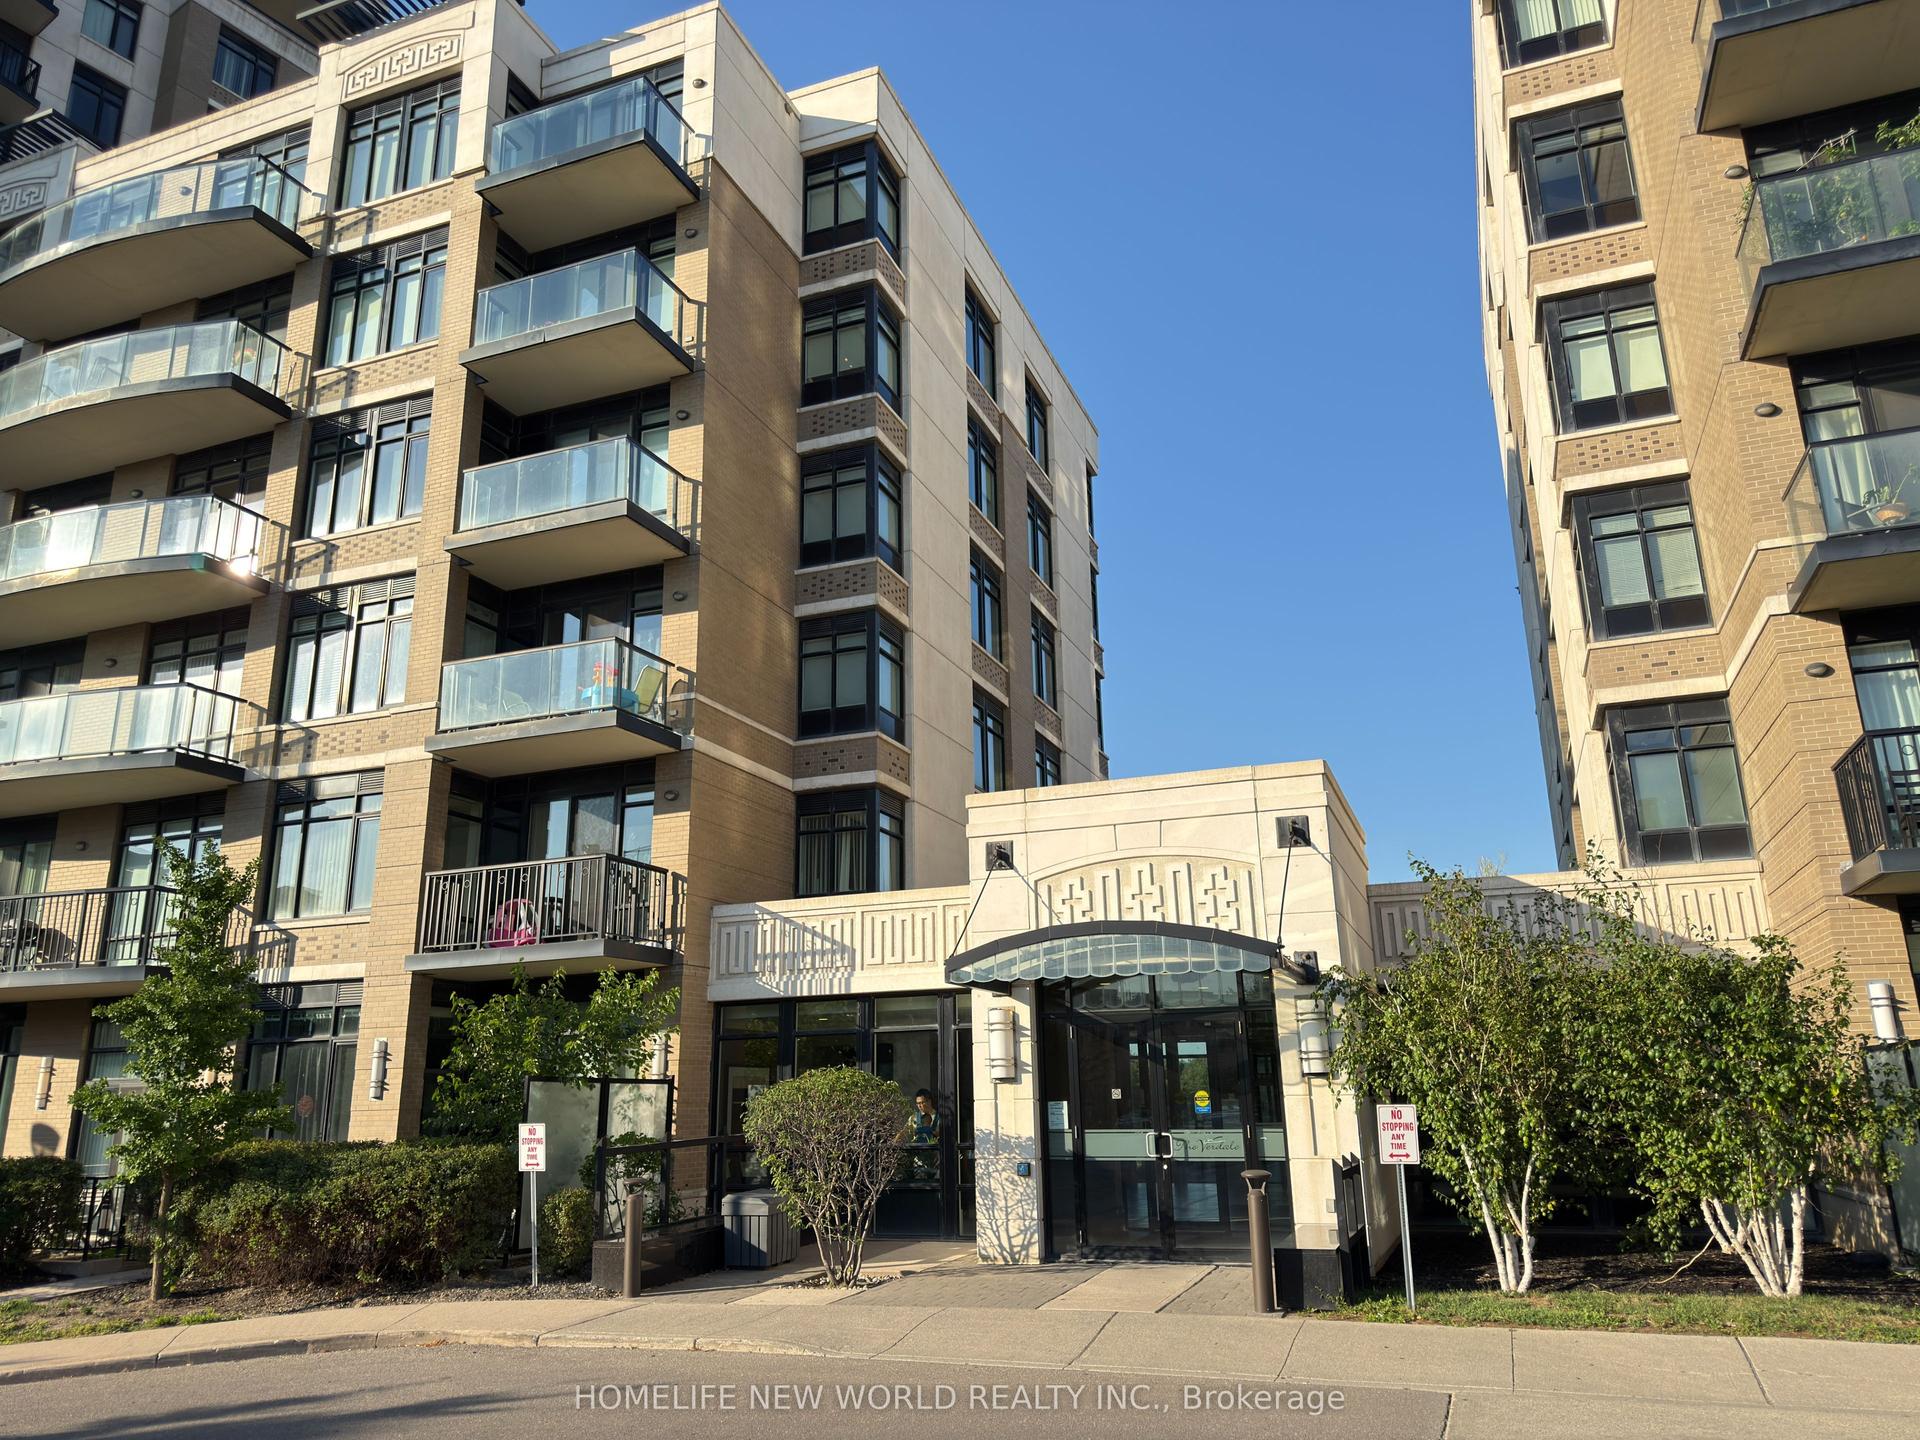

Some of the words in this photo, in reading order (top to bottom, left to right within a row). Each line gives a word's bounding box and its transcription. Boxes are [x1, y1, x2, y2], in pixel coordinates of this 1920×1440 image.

[1391, 1110, 1402, 1119] NO
[1382, 1122, 1414, 1131] STOPPING
[528, 1128, 536, 1136] NO
[1391, 1142, 1407, 1150] TIME
